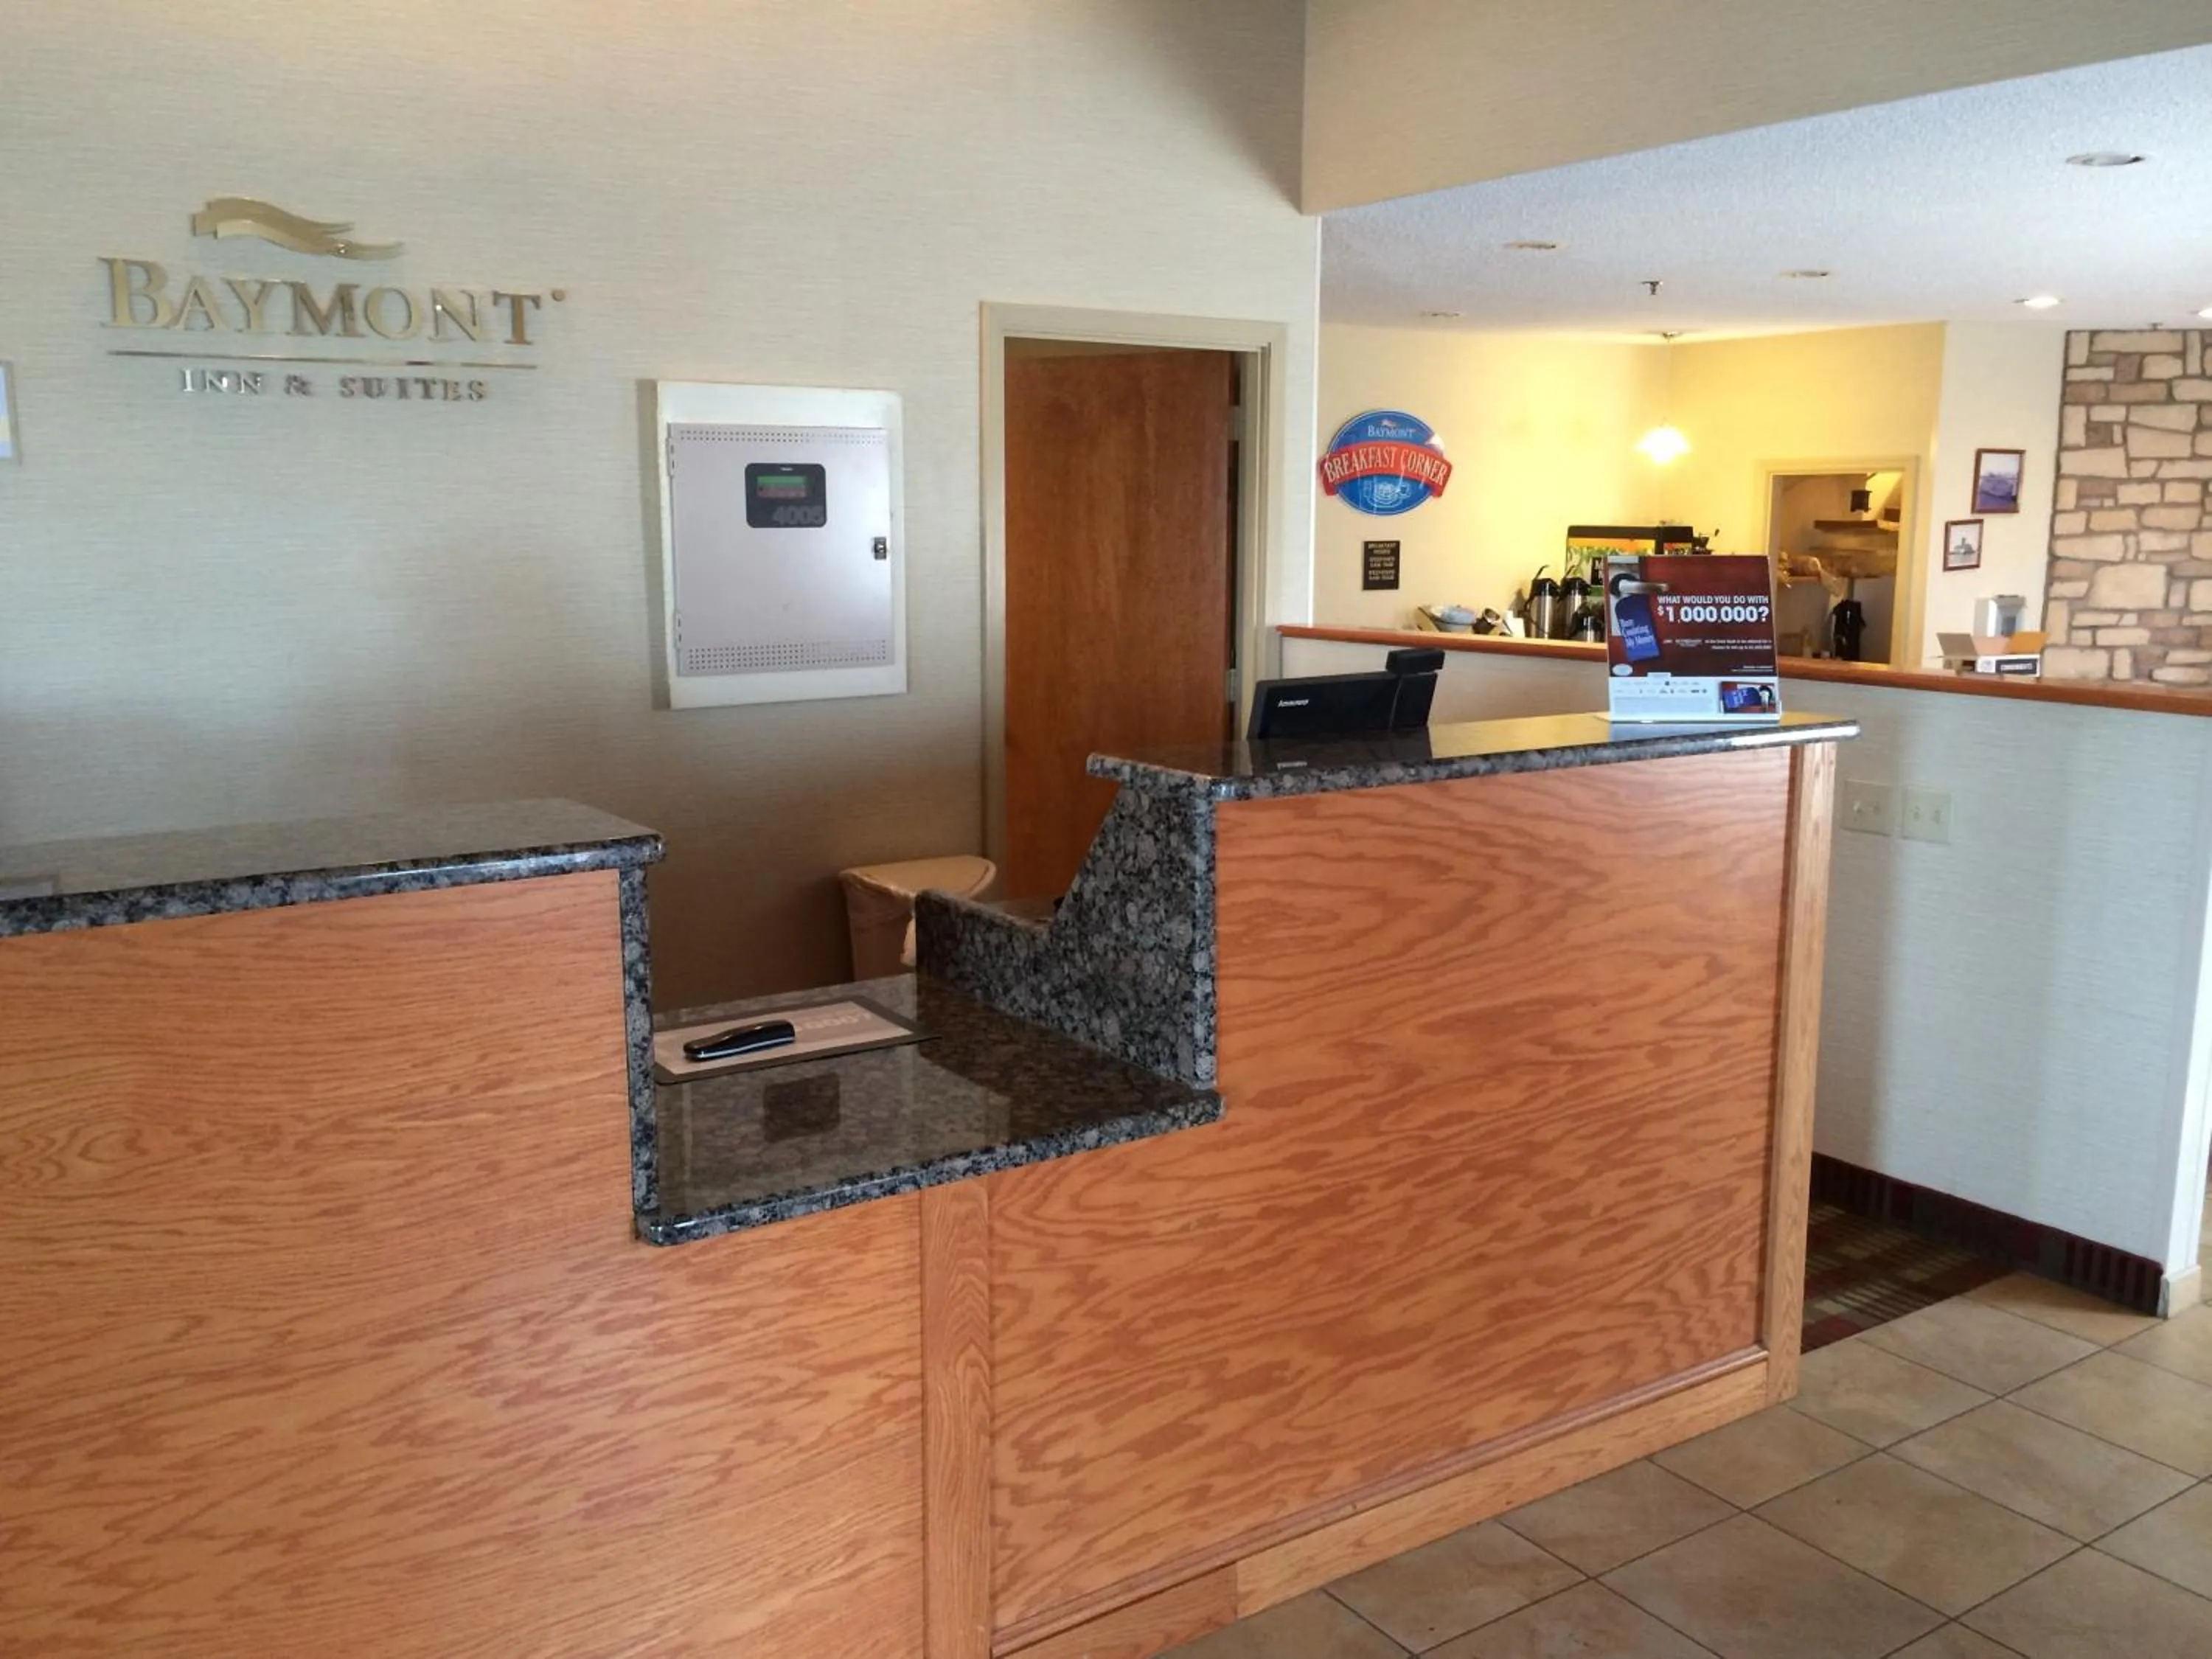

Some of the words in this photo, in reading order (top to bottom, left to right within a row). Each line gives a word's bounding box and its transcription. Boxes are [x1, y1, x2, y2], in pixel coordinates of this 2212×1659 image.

[98, 257, 541, 345] BAYMONT
[180, 368, 264, 394] INN
[284, 374, 312, 397] &
[339, 376, 488, 402] SUITES
[1367, 425, 1415, 438] BAYMONT
[1325, 445, 1397, 483] BREAKFAST
[1402, 448, 1448, 487] CORNER
[1657, 595, 1680, 605] WHAT
[1682, 595, 1714, 605] WOULD
[1714, 595, 1731, 605] YOU
[1733, 595, 1746, 605] DO
[1747, 595, 1769, 605] WITH
